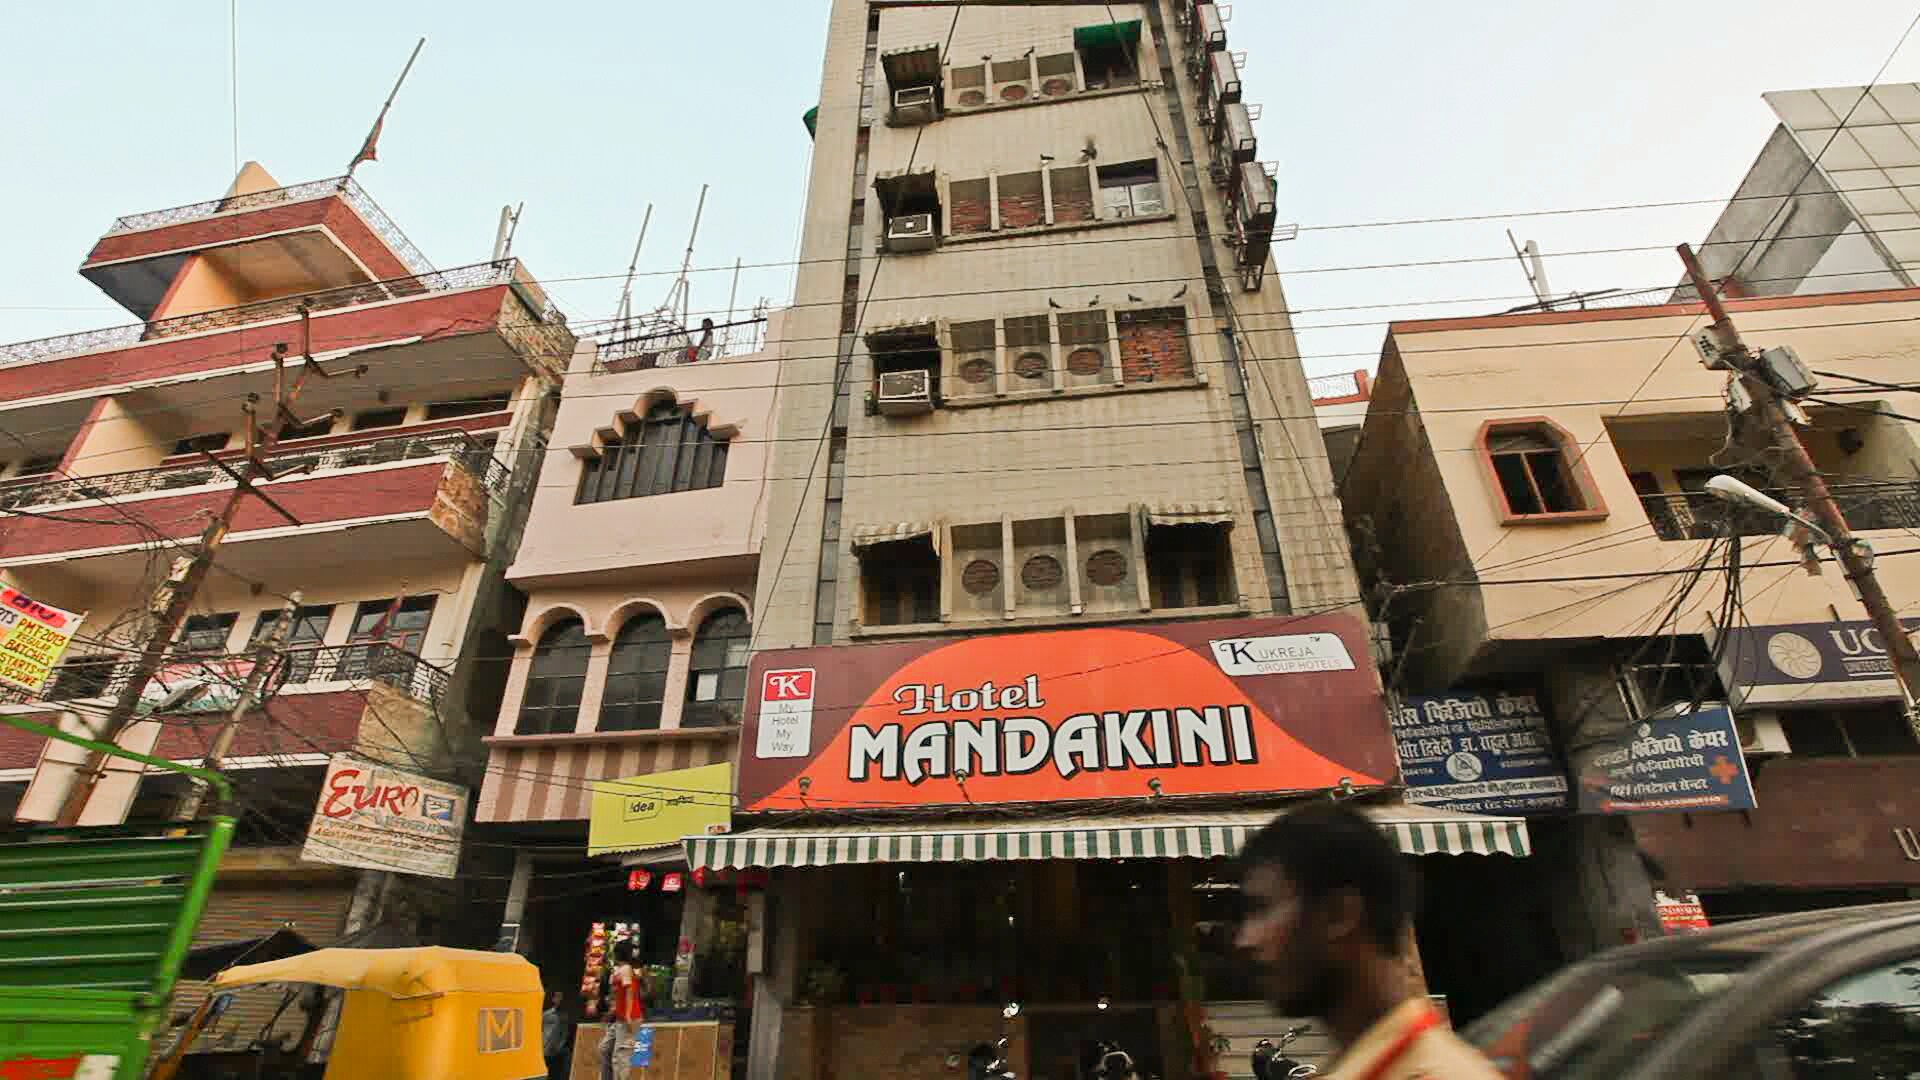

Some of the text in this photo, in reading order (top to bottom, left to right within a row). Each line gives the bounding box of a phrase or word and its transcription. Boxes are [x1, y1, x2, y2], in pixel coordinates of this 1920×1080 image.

[5, 640, 53, 666] BATCHES
[1256, 658, 1342, 673] GROUP HOTELS
[769, 675, 808, 697] K
[893, 675, 1045, 715] Hotel
[779, 703, 794, 714] My
[771, 715, 799, 726] Hotel
[776, 729, 792, 740] My
[1687, 729, 1729, 749] केयर
[771, 742, 795, 753] Way
[848, 705, 1258, 785] MANDAKINI
